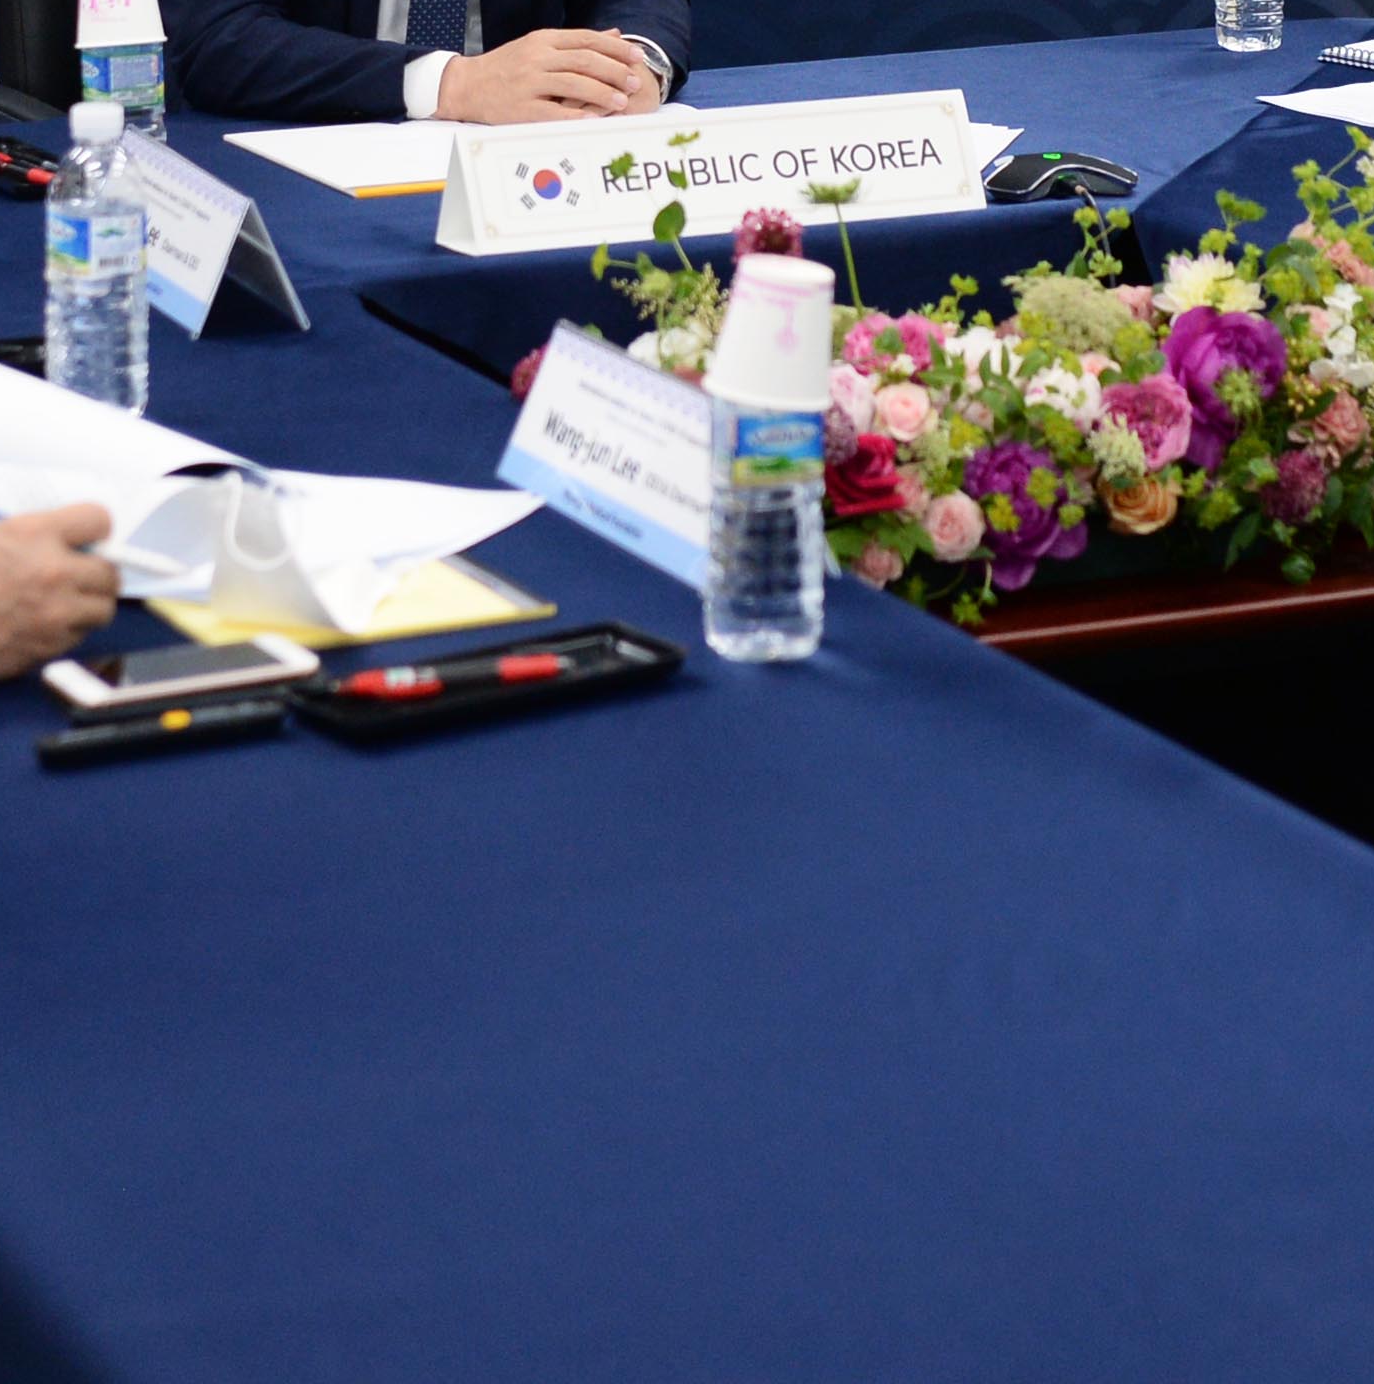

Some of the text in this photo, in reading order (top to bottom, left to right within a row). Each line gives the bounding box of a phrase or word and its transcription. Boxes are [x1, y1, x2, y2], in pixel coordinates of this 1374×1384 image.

[772, 148, 818, 179] OF
[830, 137, 942, 174] KOREA
[611, 444, 641, 482] Lee
